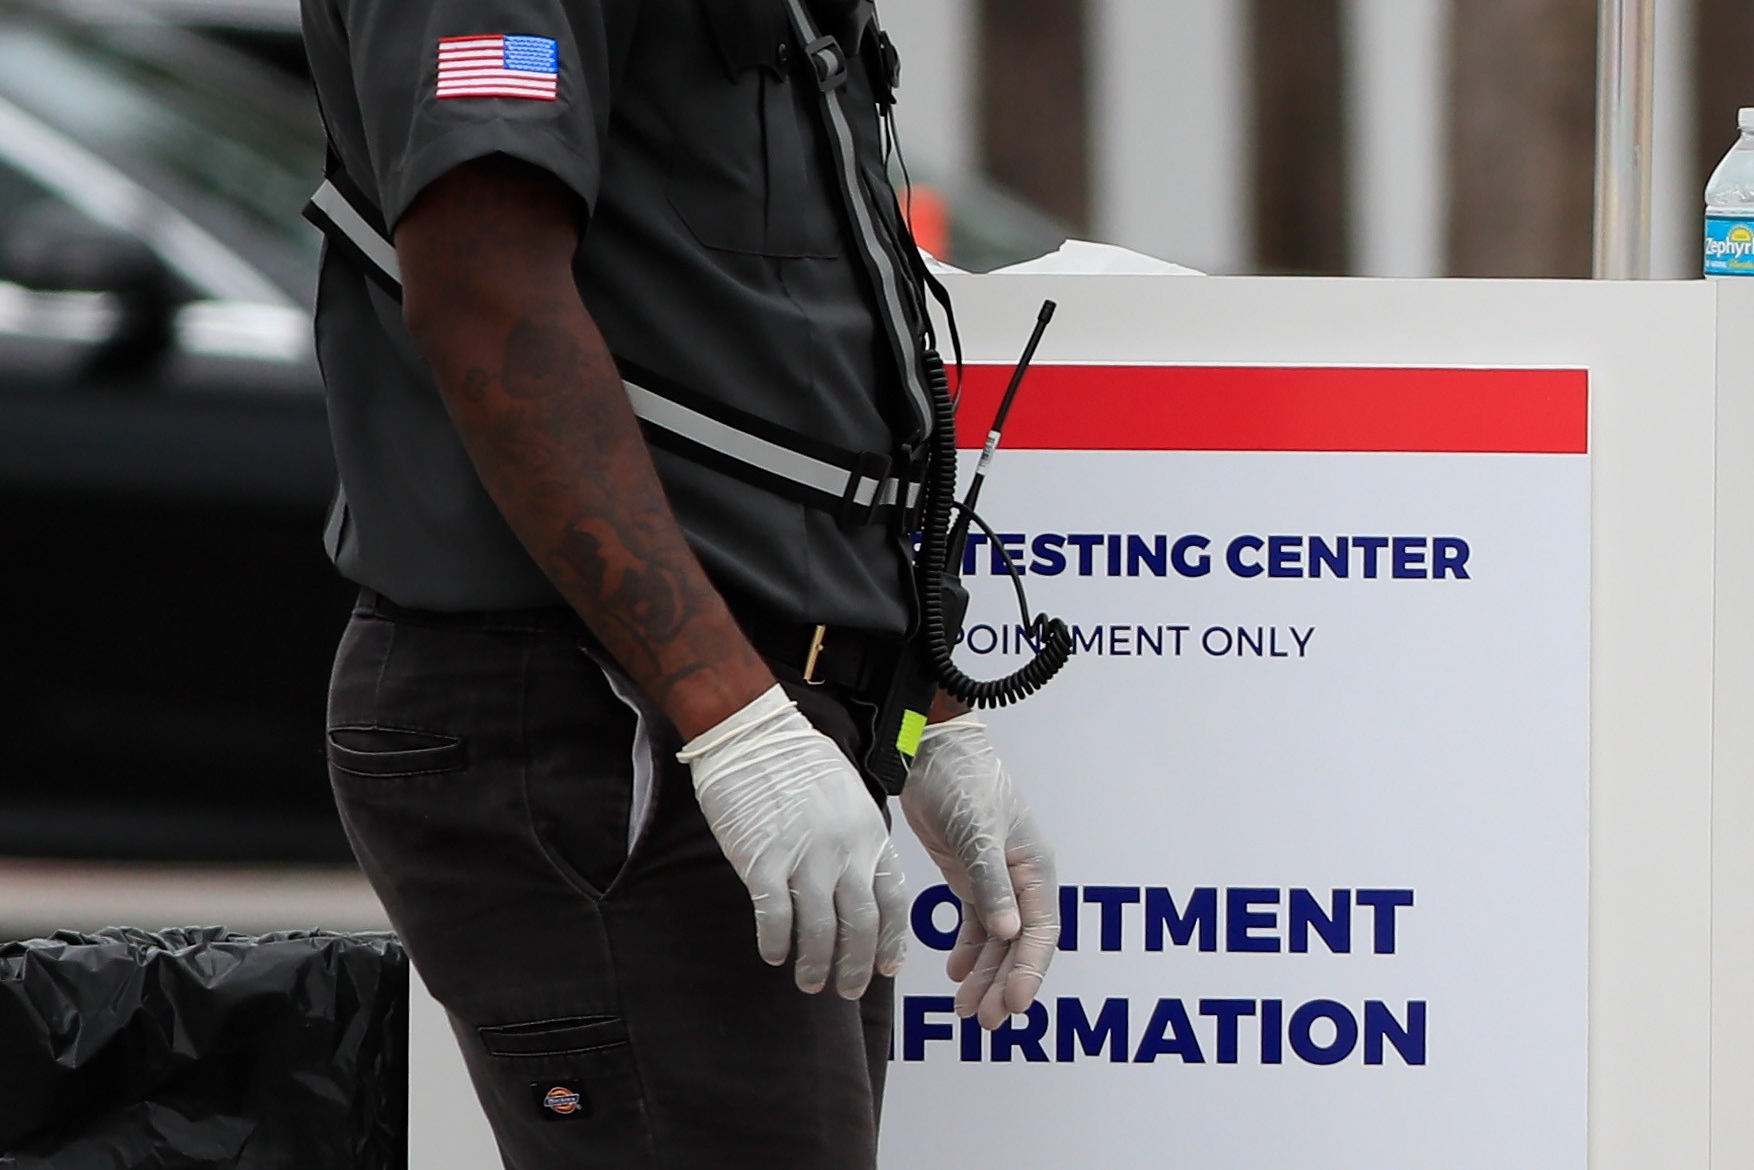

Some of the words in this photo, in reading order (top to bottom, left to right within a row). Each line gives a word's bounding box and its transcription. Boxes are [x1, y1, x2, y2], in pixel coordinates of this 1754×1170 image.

[962, 533, 1211, 578] TESTING
[1226, 534, 1471, 580] CENTER
[954, 623, 1189, 656] OINMENT
[1201, 625, 1316, 658] ONLY
[888, 995, 1428, 1067] FIRMATION
